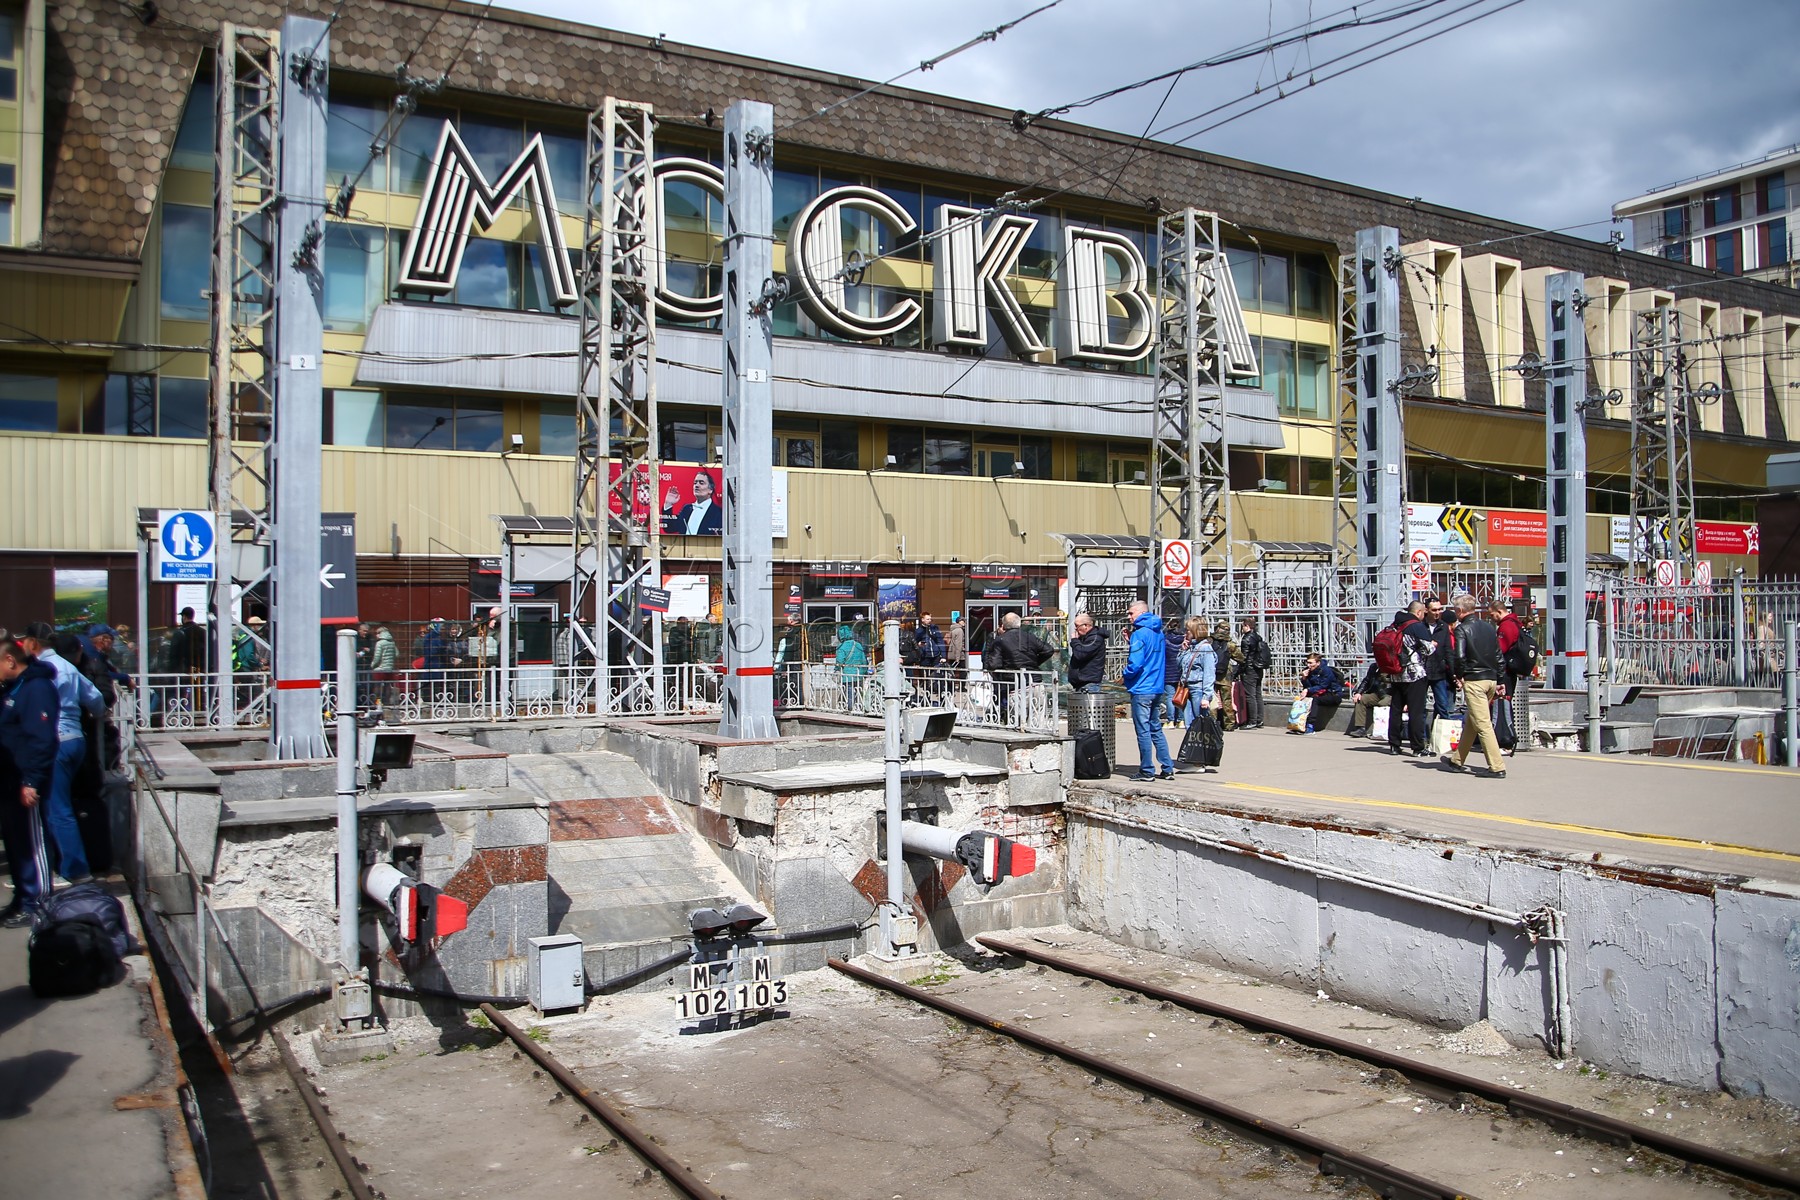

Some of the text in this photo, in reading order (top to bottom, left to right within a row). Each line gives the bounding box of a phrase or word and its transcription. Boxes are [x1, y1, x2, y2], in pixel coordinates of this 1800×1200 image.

[400, 117, 1261, 378] МОСКВА
[1188, 731, 1217, 746] BOSS
[677, 991, 728, 1018] 102
[738, 981, 787, 1009] 103
